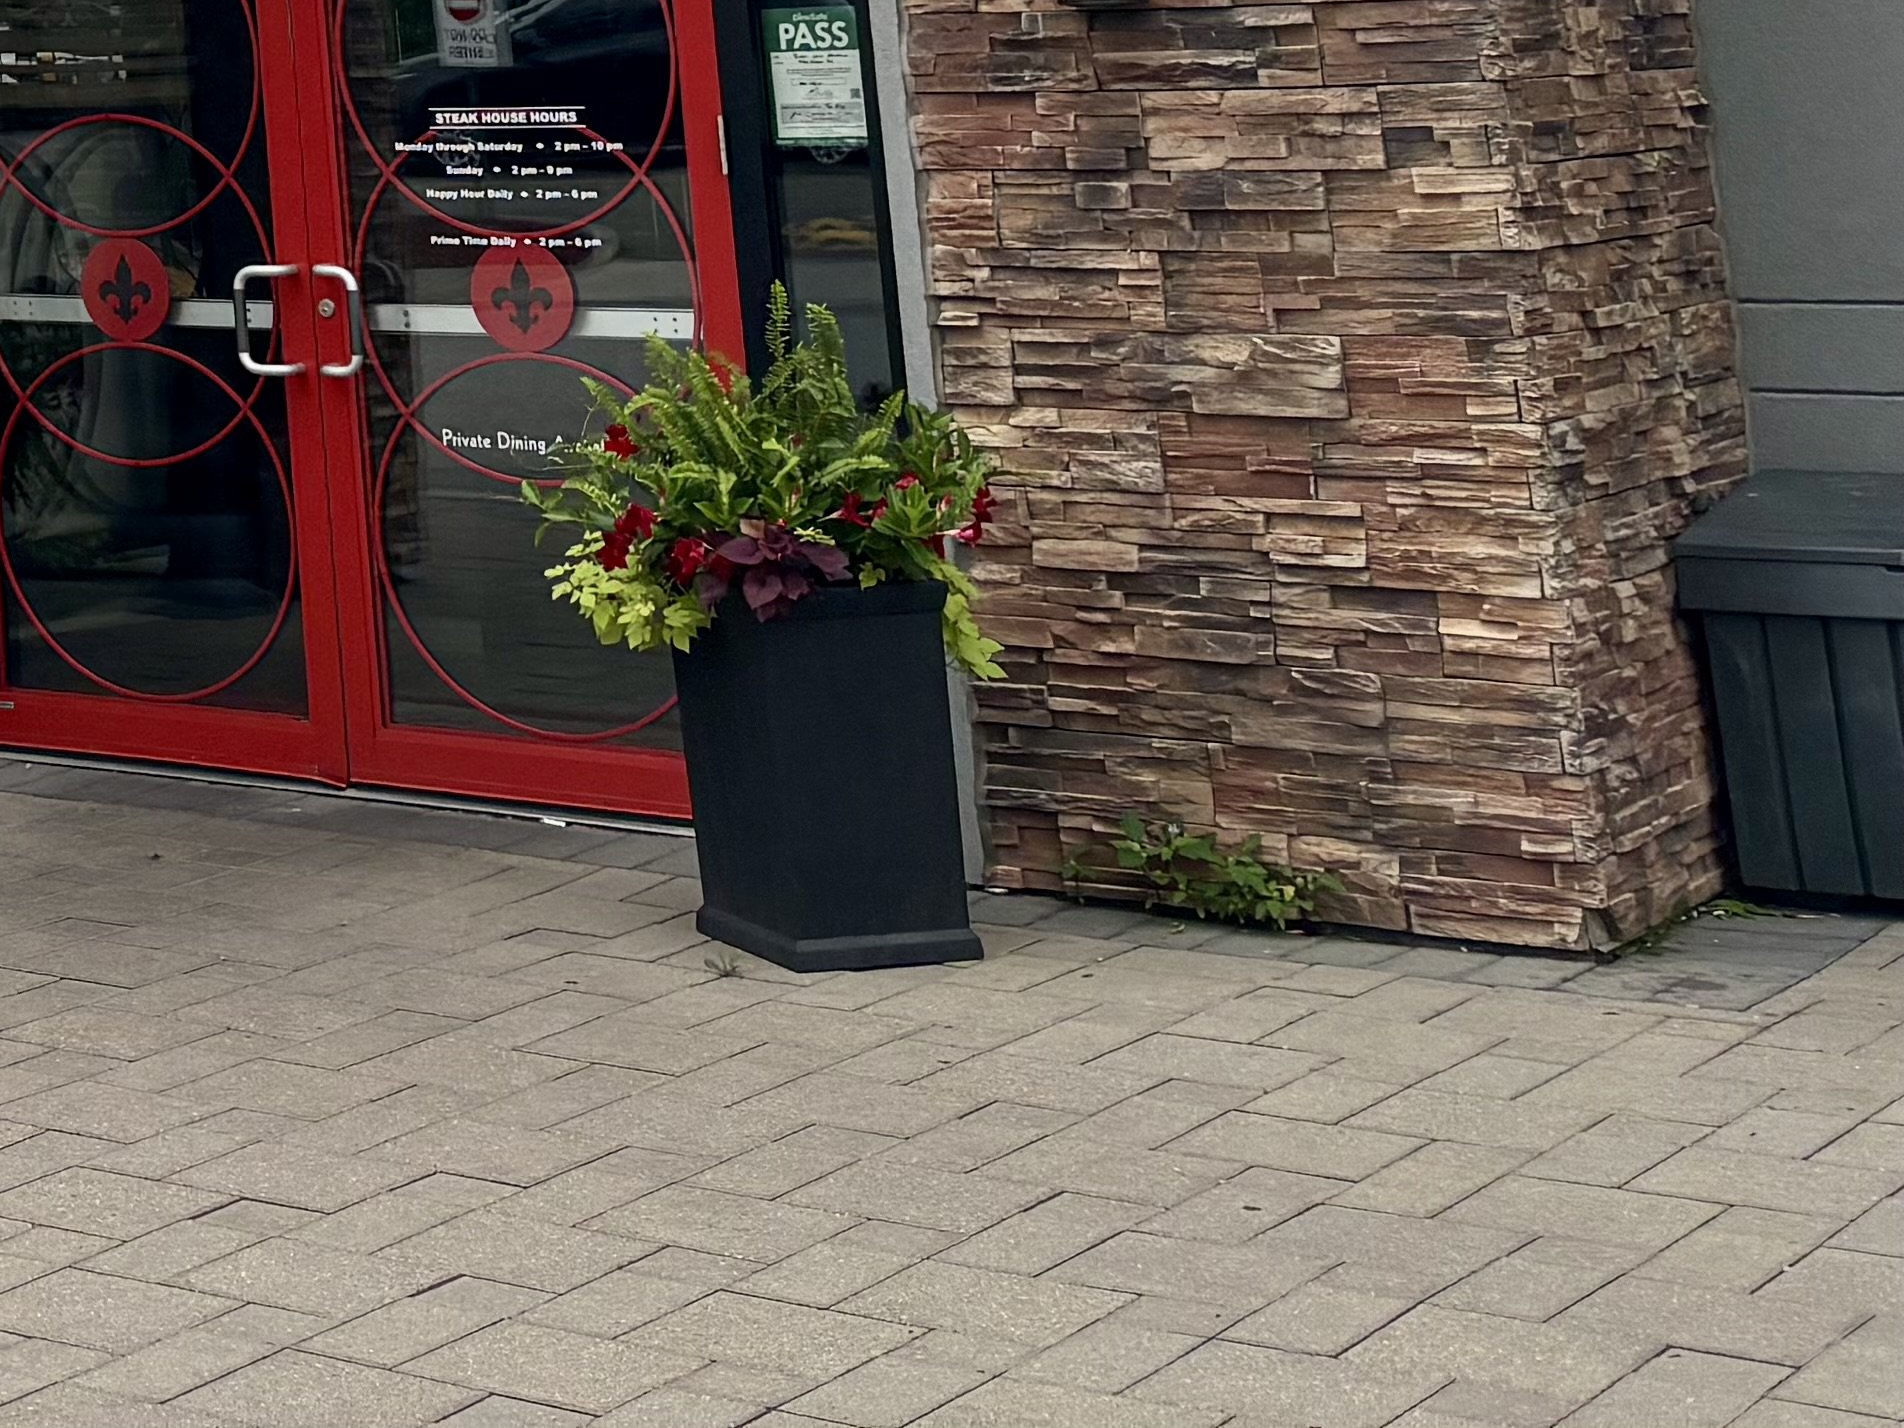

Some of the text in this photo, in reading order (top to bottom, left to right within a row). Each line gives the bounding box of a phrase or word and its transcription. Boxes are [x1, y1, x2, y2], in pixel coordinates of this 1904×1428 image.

[778, 21, 849, 50] PASS
[435, 111, 577, 125] STEAK HOUSE HOURS
[394, 142, 434, 153] Monday
[435, 142, 475, 153] through
[477, 141, 523, 153] Saturday
[554, 141, 562, 151] 2
[564, 143, 581, 152] pm
[591, 141, 604, 151] 10
[605, 143, 624, 152] pm
[446, 165, 484, 177] Sunday
[511, 165, 519, 175] 2
[520, 167, 538, 176] pm
[556, 167, 573, 176] pm
[426, 188, 458, 200] Happy
[460, 188, 485, 198] Hour
[487, 189, 513, 201] Daily
[535, 189, 543, 199] 2
[545, 191, 562, 200] pm
[580, 191, 598, 200] pm
[430, 235, 460, 245] Prime
[461, 235, 488, 246] Time
[490, 236, 516, 248] Daily
[538, 237, 546, 247] 2
[548, 239, 565, 248] pm
[584, 239, 602, 248] pm
[442, 428, 492, 448] Private
[496, 430, 546, 455] Dining
